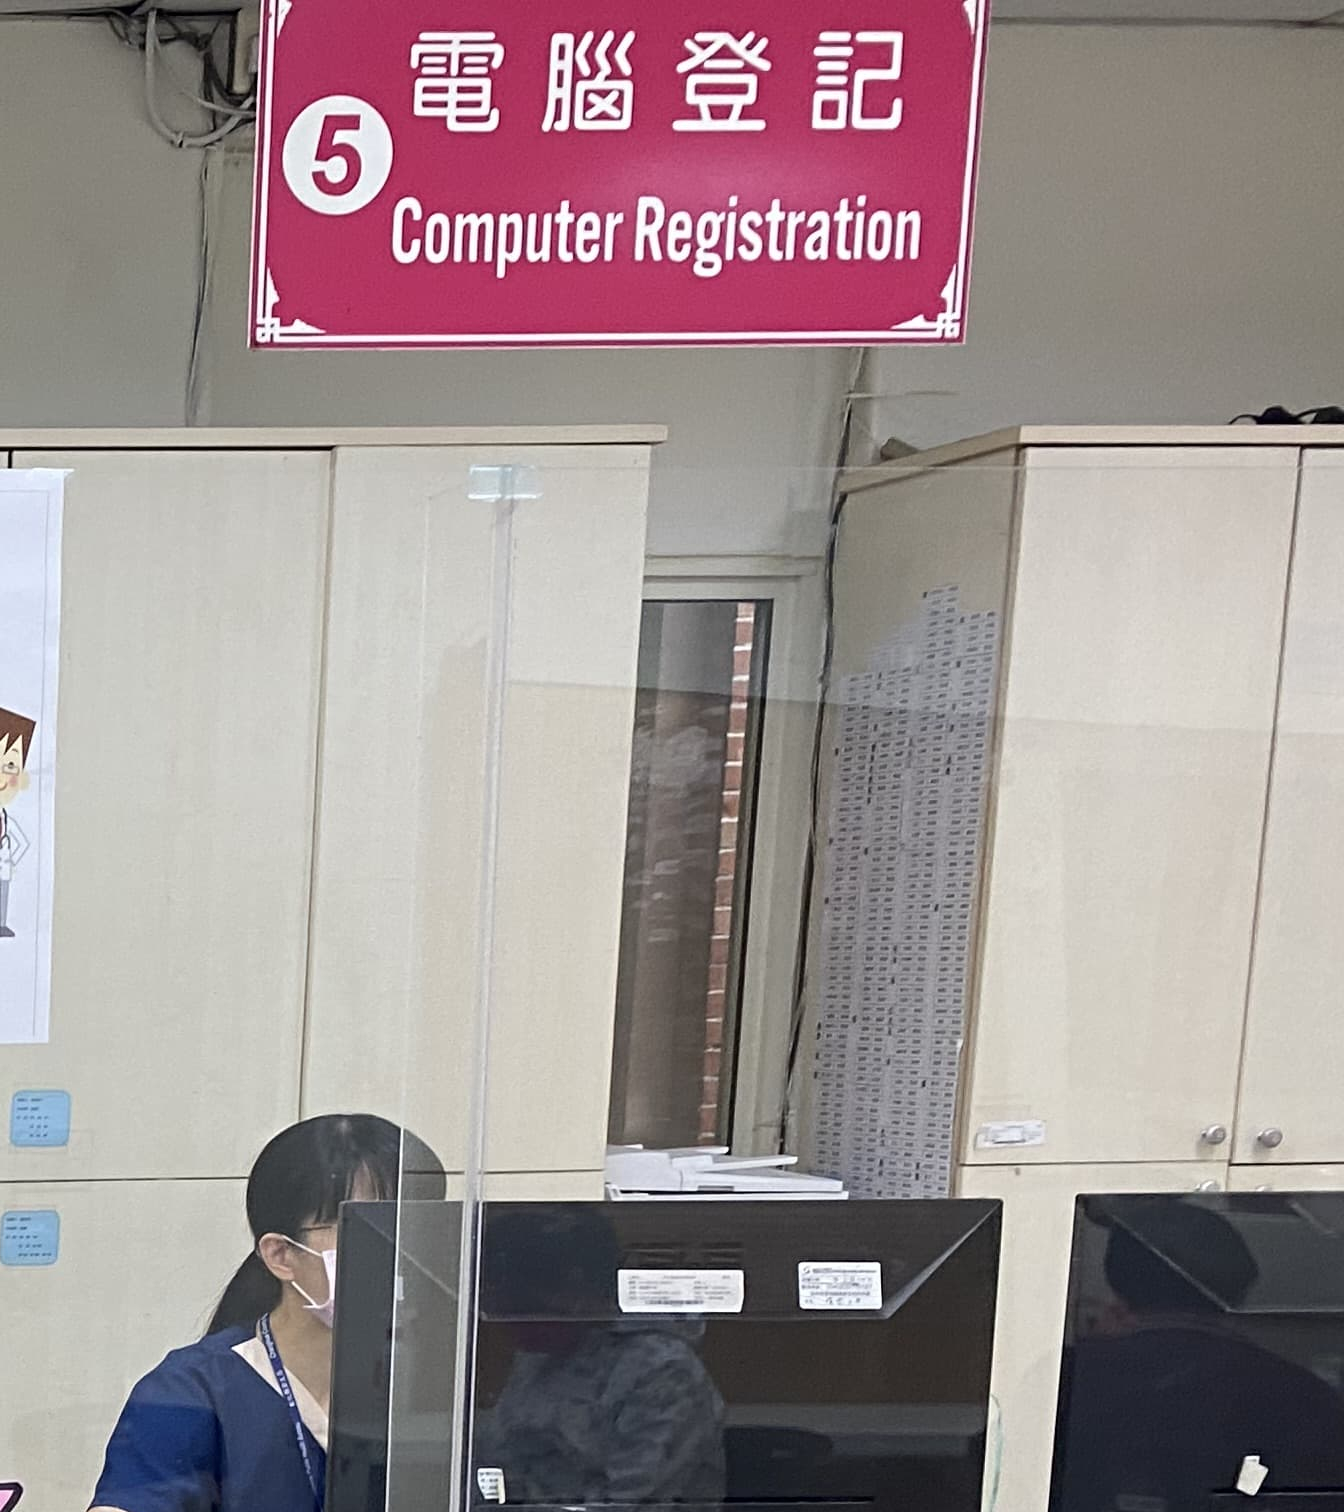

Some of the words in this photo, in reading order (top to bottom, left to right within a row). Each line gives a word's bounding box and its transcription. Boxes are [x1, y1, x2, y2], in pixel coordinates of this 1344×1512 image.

[410, 30, 905, 134] 電腦登記
[311, 113, 363, 197] 5
[391, 196, 624, 279] Computer
[634, 194, 922, 277] Registration
